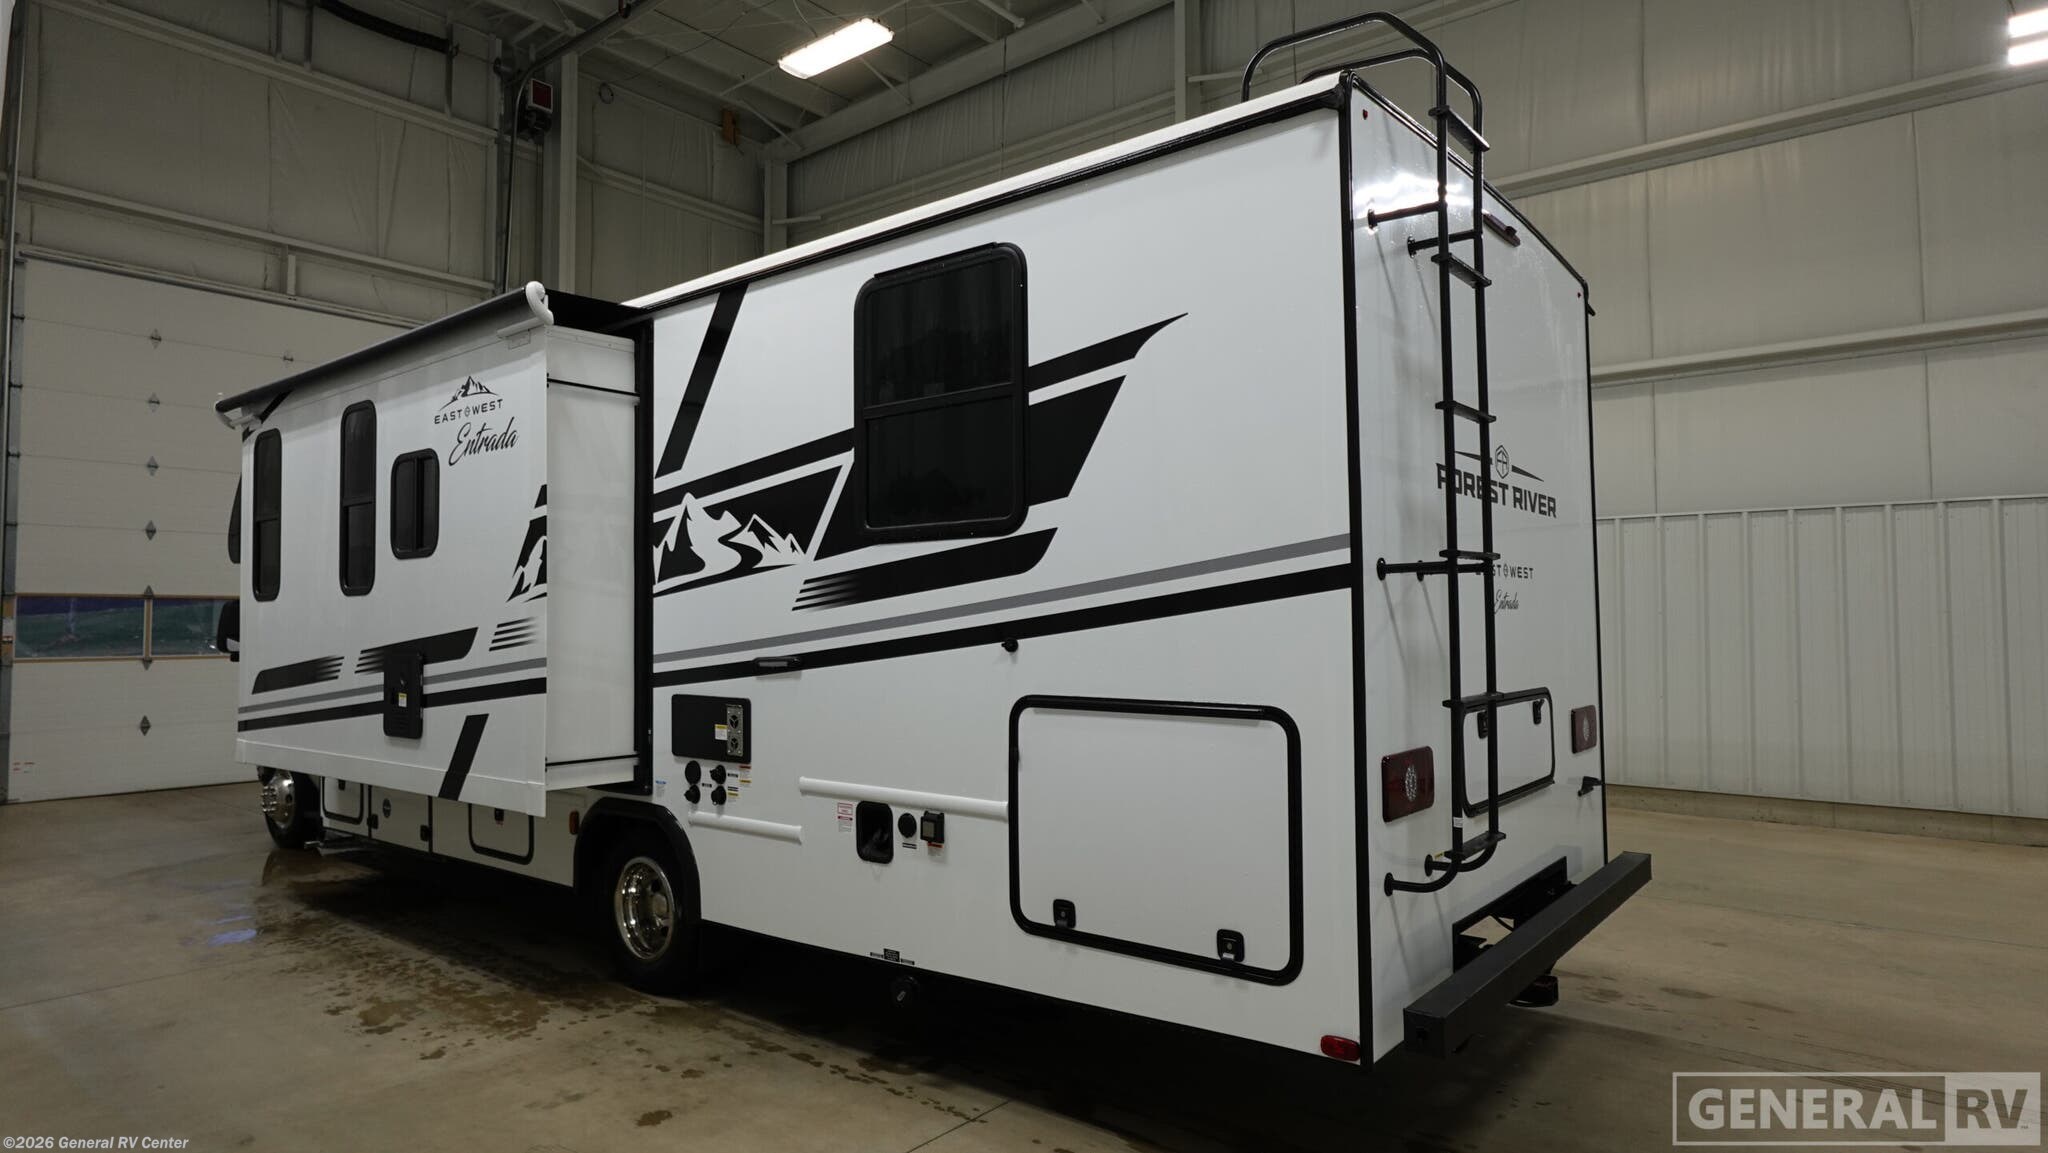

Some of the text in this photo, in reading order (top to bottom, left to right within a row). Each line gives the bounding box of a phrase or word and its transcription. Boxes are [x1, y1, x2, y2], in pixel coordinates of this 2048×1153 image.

[434, 398, 503, 425] EAST WEST
[448, 416, 519, 467] Entrada
[1512, 485, 1557, 518] RIVER
[1509, 565, 1534, 580] WEST
